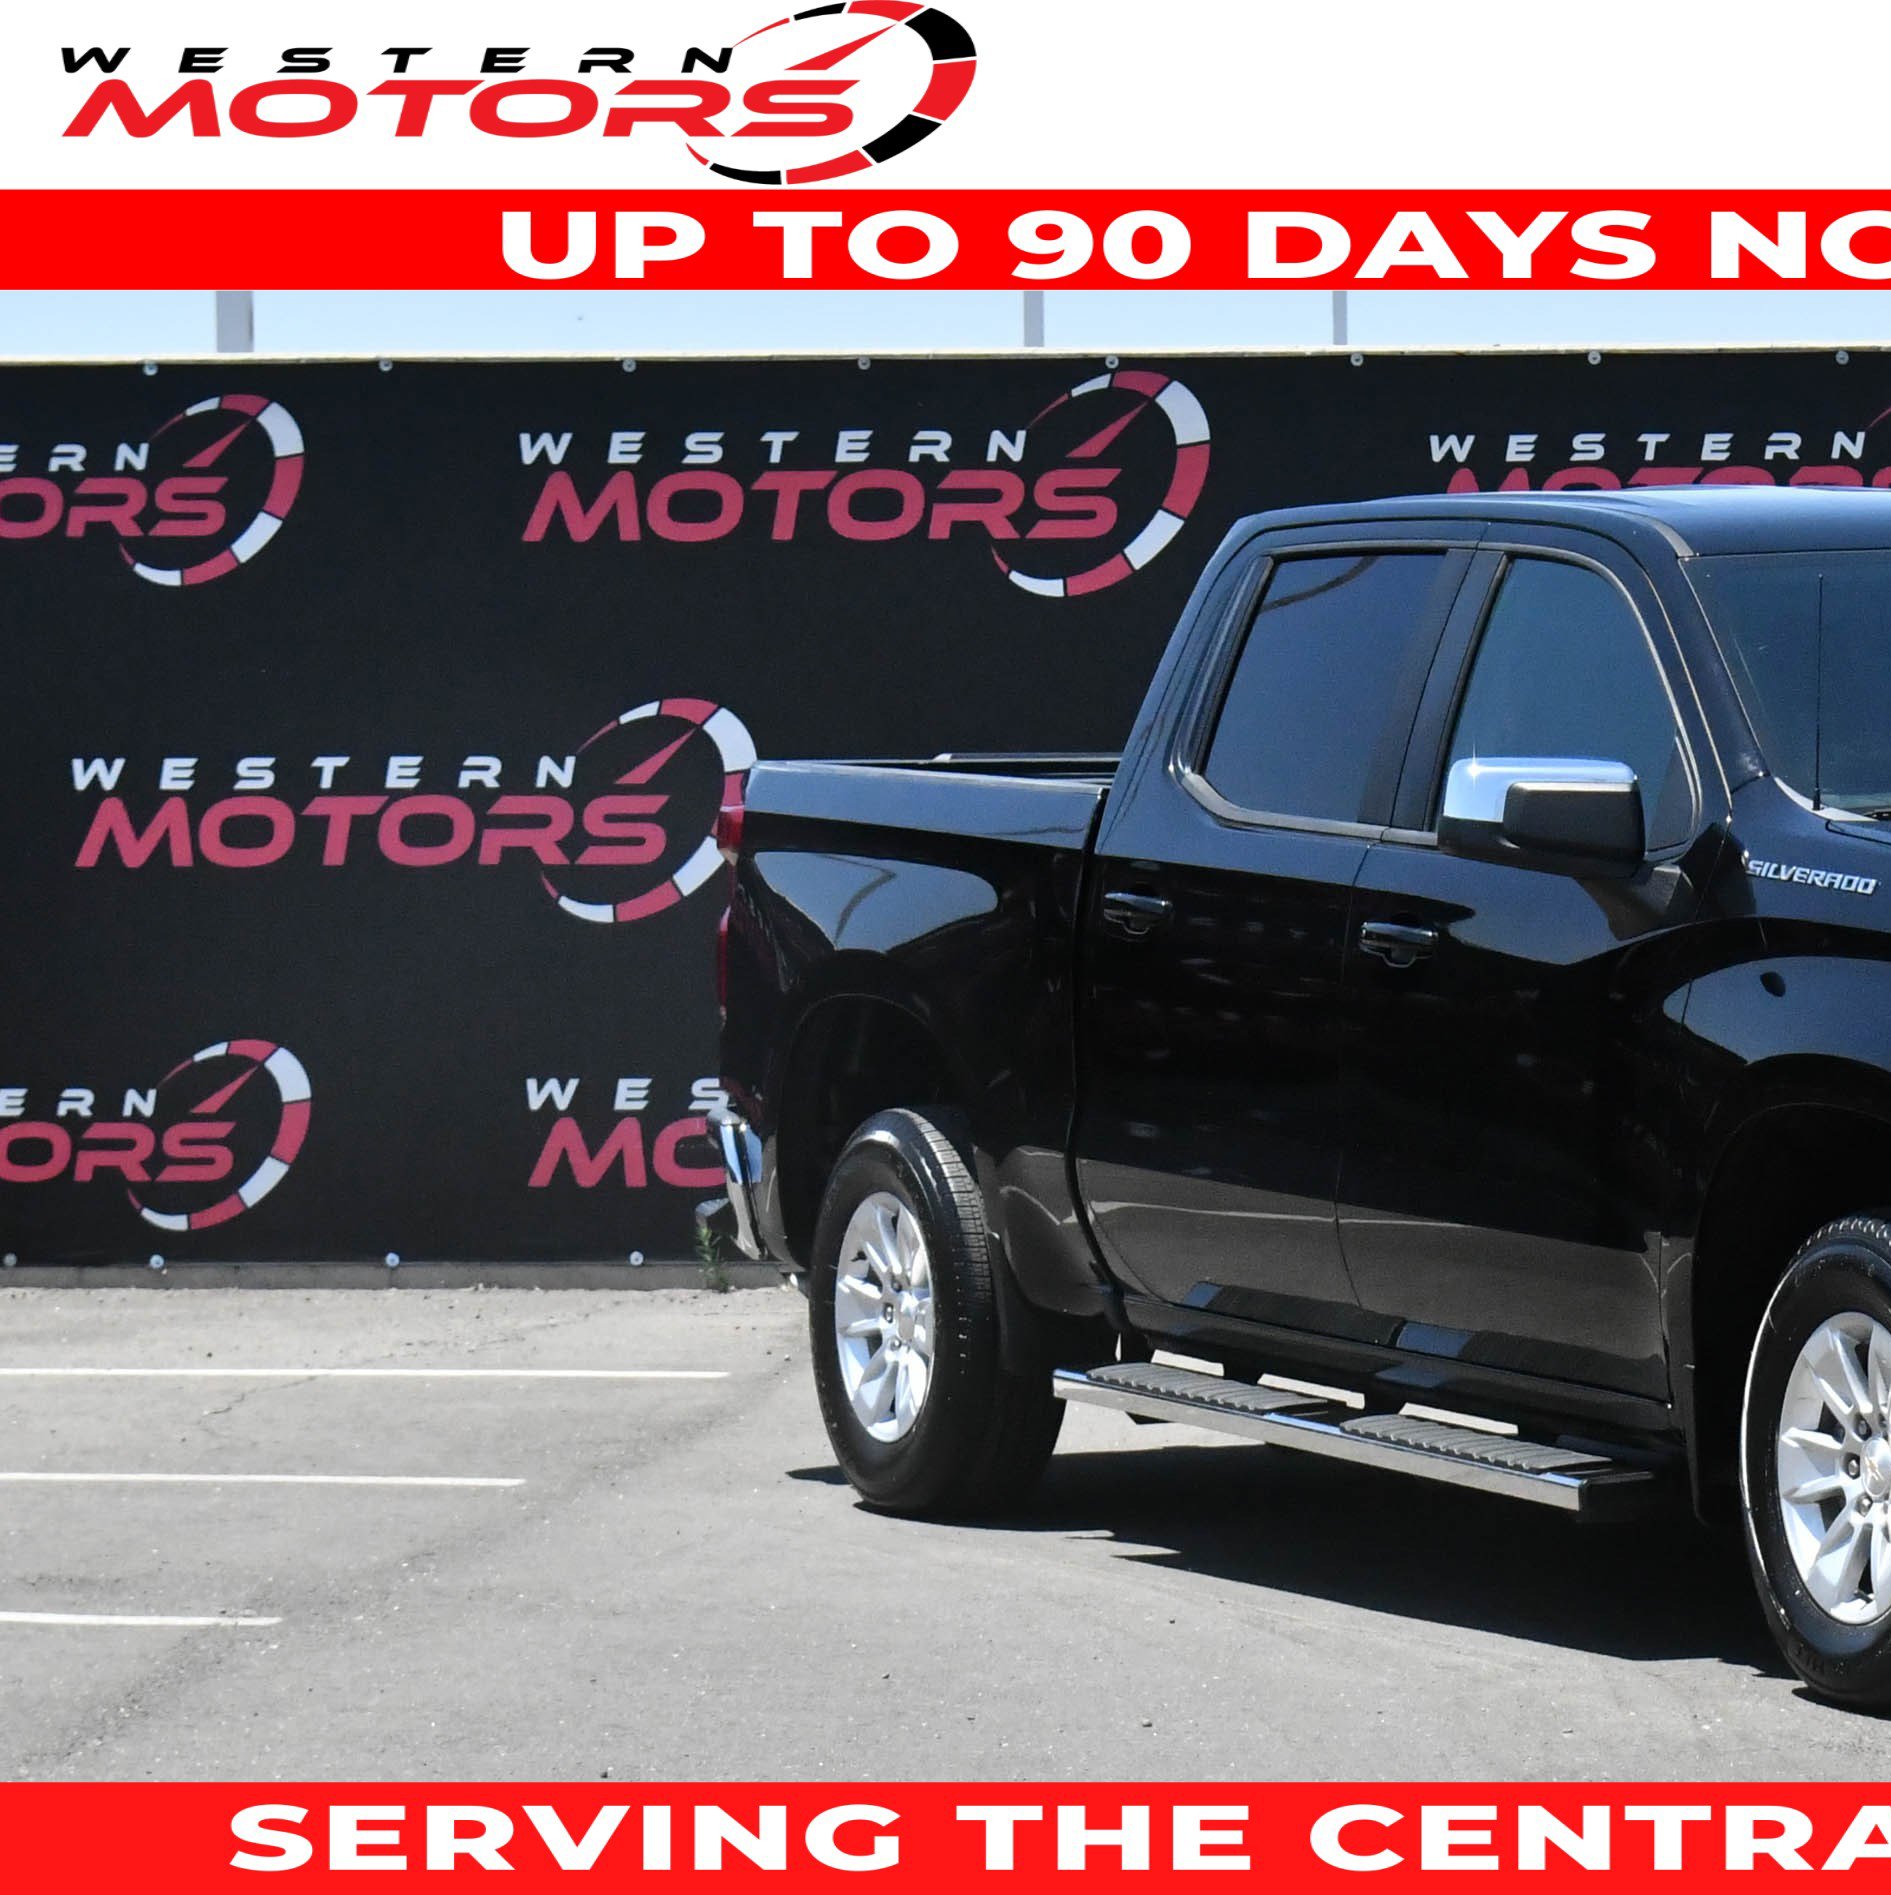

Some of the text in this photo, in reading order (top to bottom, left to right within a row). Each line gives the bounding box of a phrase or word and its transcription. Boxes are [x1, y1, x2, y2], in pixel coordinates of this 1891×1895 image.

[519, 429, 1027, 465] WESTERN
[1430, 432, 1866, 463] WESTERN
[523, 468, 1121, 542] MOTORS
[72, 755, 576, 791] WESTERN
[75, 795, 669, 868] MOTORS
[1746, 858, 1878, 896] SILVERADO
